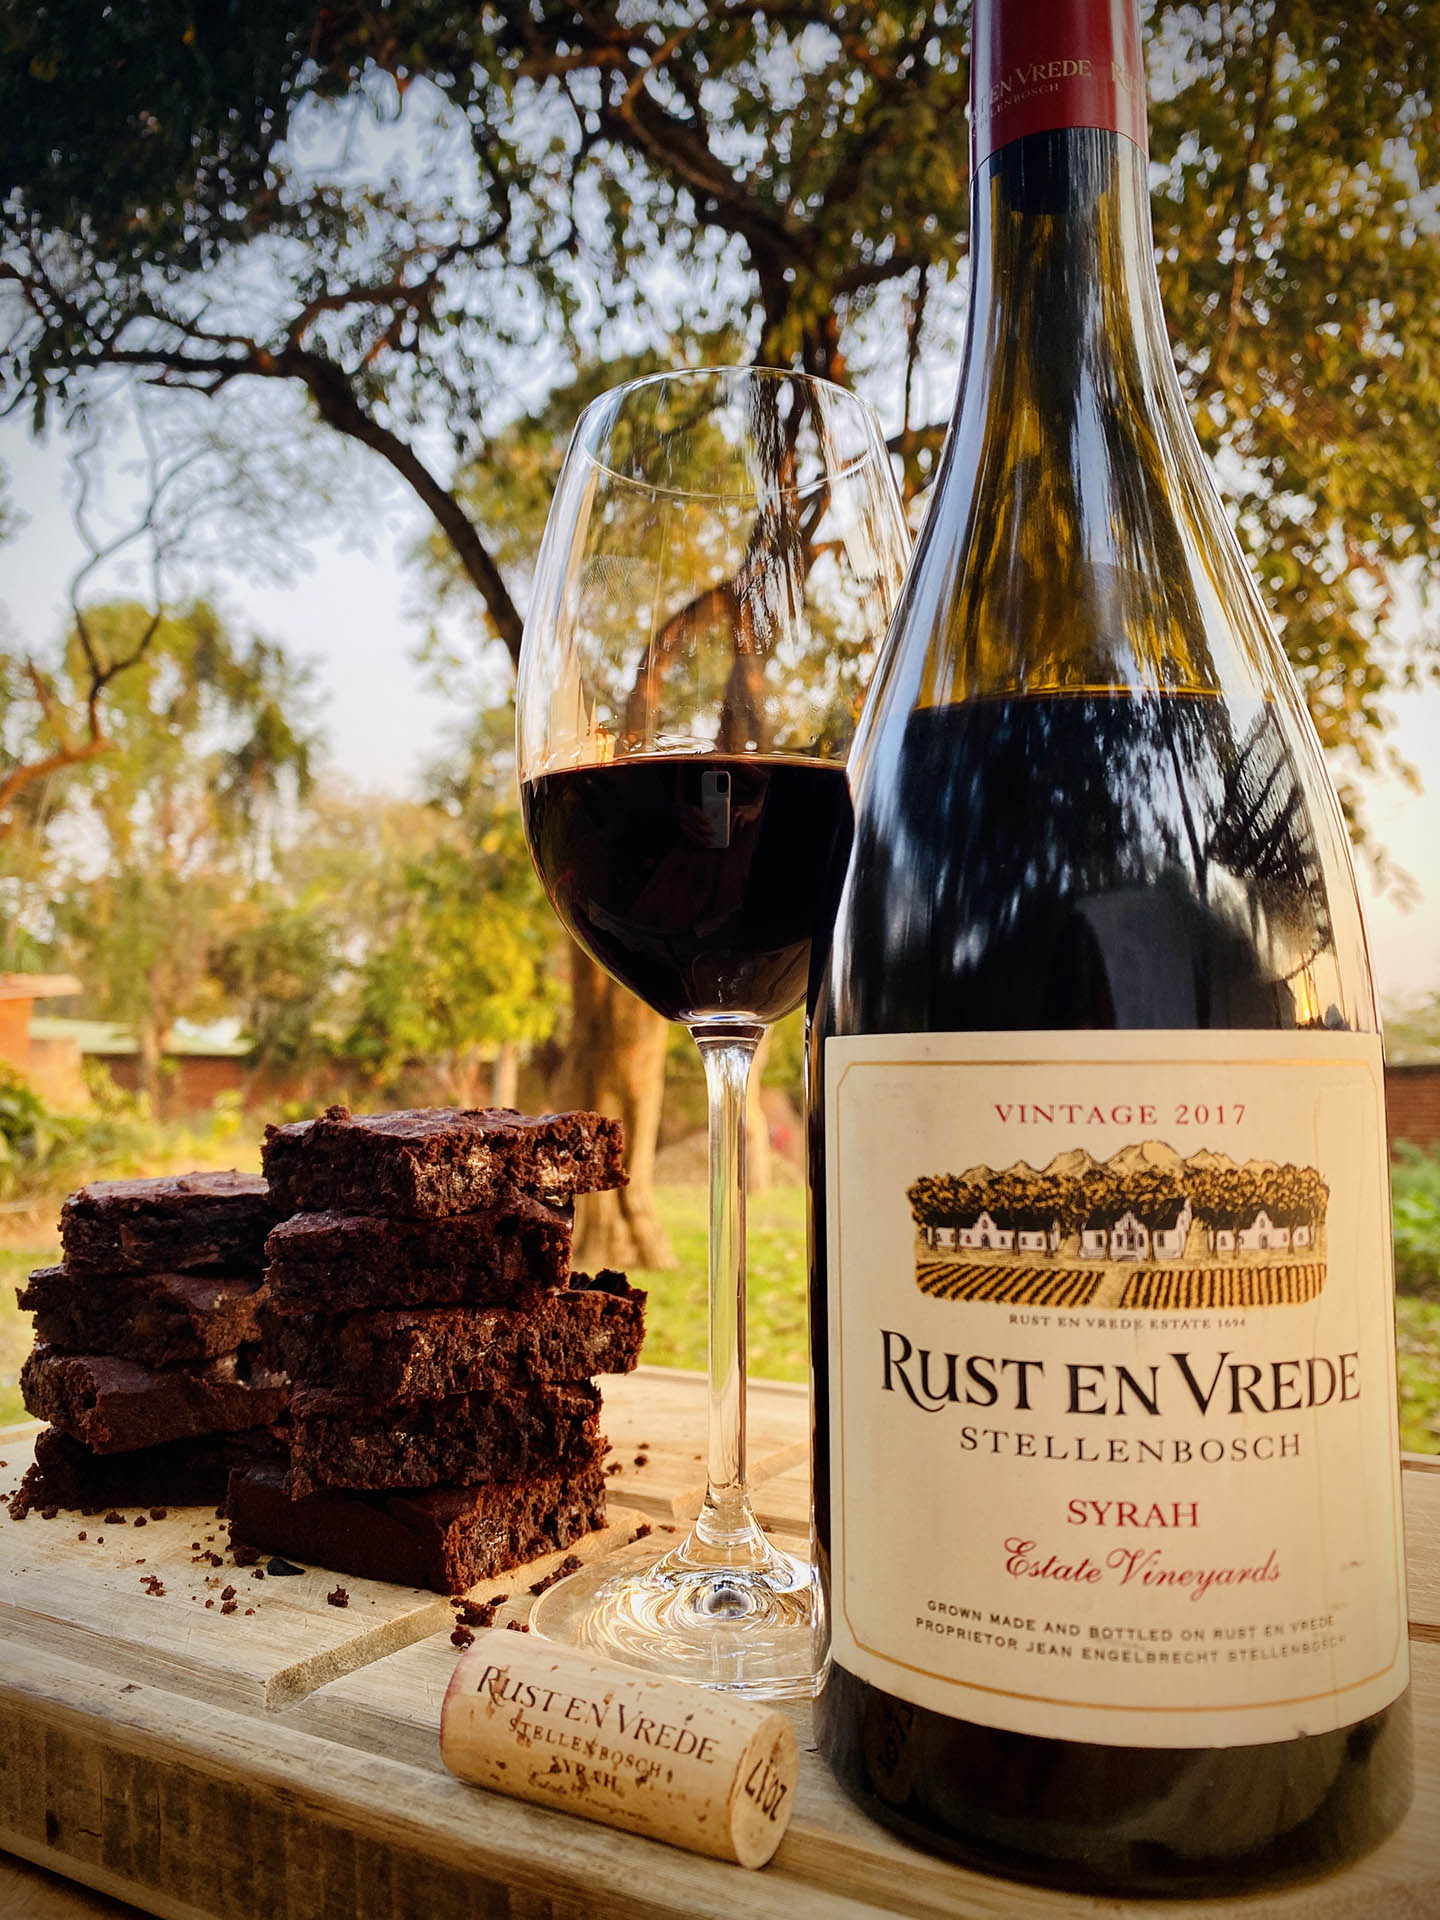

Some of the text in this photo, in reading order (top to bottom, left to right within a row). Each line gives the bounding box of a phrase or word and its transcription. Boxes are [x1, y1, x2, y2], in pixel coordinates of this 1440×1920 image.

[1016, 60, 1093, 85] VREDE
[994, 1104, 1246, 1125] VINTAGE 2017
[1009, 1314, 1246, 1330] RUST EN VREDE ESTATE 1694
[880, 1329, 1361, 1416] RUST EN VREDE
[960, 1426, 1301, 1464] STELLENBOSCH
[1067, 1499, 1199, 1528] SYRAH
[1004, 1537, 1281, 1602] Estate Vineyards
[915, 1617, 1346, 1665] PROPRIETOR JEAN ENGELBRECHT STELLENBOSCH
[927, 1600, 1336, 1642] GROWN MADE AND BOTTLED ON RUST EN VREDE
[477, 1665, 721, 1765] RUST EN VREDE
[508, 1716, 662, 1778] STELLENBOSCH
[744, 1757, 788, 1823] 2017
